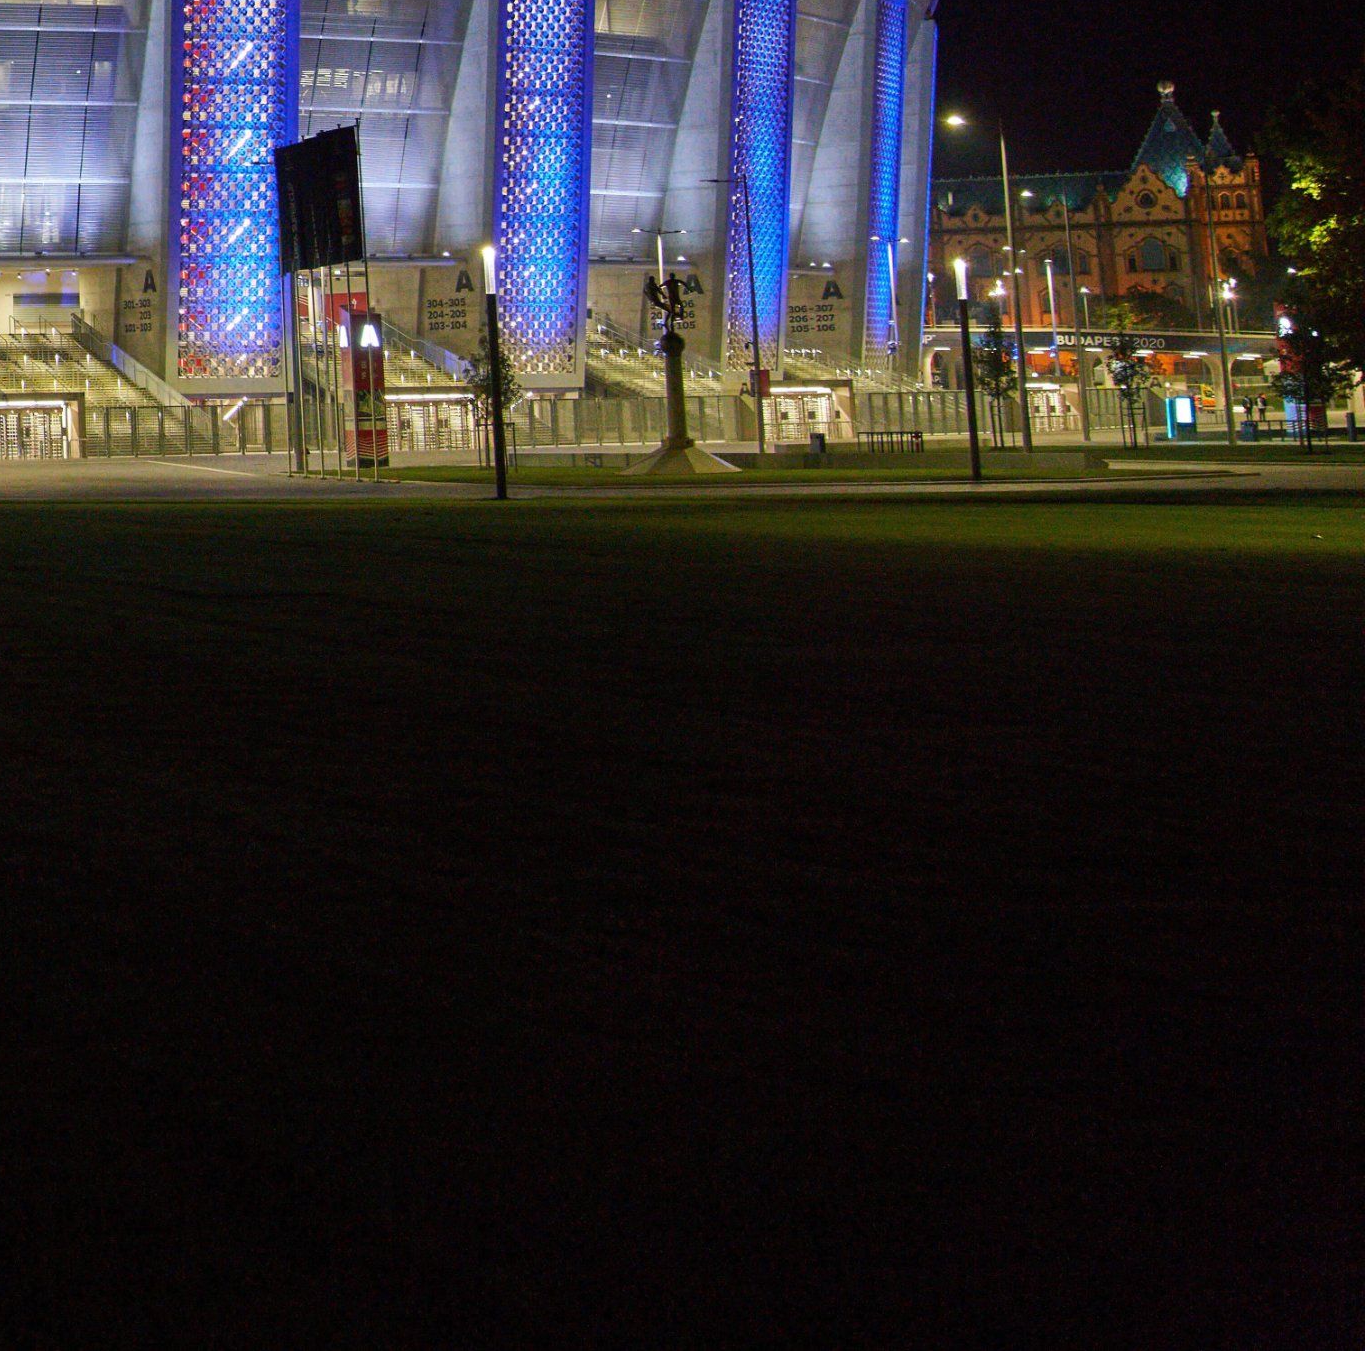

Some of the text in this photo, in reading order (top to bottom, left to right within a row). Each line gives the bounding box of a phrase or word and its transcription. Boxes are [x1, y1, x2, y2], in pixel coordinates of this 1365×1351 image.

[143, 269, 157, 293] A
[455, 269, 475, 293] A
[683, 274, 704, 295] A
[821, 280, 844, 300] A
[426, 297, 467, 309] 304-305
[788, 304, 834, 314] 306-307
[427, 309, 468, 320] 204-205
[789, 314, 835, 324] 206-207
[429, 320, 468, 331] 103-104
[790, 324, 836, 333] 105-106
[360, 324, 380, 348] A
[1056, 335, 1165, 349] BUDAPES 2020
